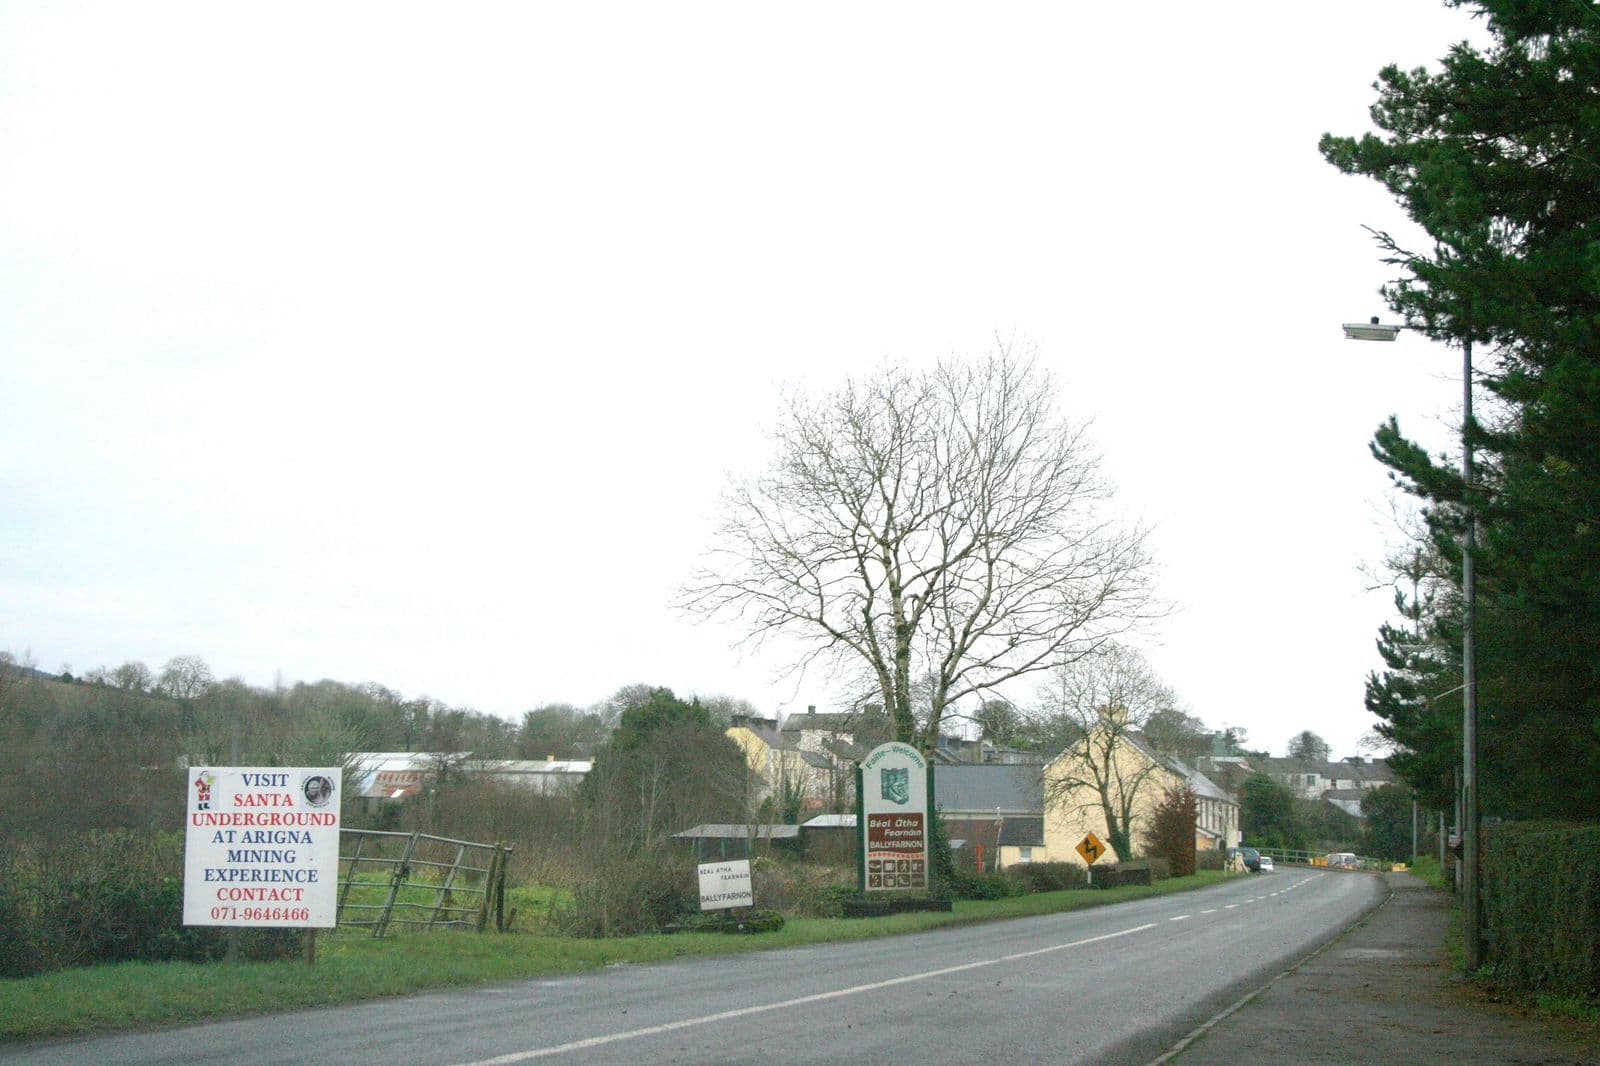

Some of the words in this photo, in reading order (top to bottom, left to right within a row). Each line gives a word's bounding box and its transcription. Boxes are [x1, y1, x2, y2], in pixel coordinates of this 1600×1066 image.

[241, 773, 290, 787] VISIT
[233, 793, 294, 807] SANTA
[191, 813, 336, 826] UNDERGROUND
[212, 830, 236, 843] AT
[241, 830, 313, 844] ARIGNA
[869, 840, 923, 849] BALLYFARNON
[227, 849, 297, 863] MINING
[204, 868, 318, 883] EXPERIENCE
[216, 887, 304, 901] CONTACT
[700, 890, 752, 903] BALLYFARNON
[210, 907, 309, 921] 071-9646466
